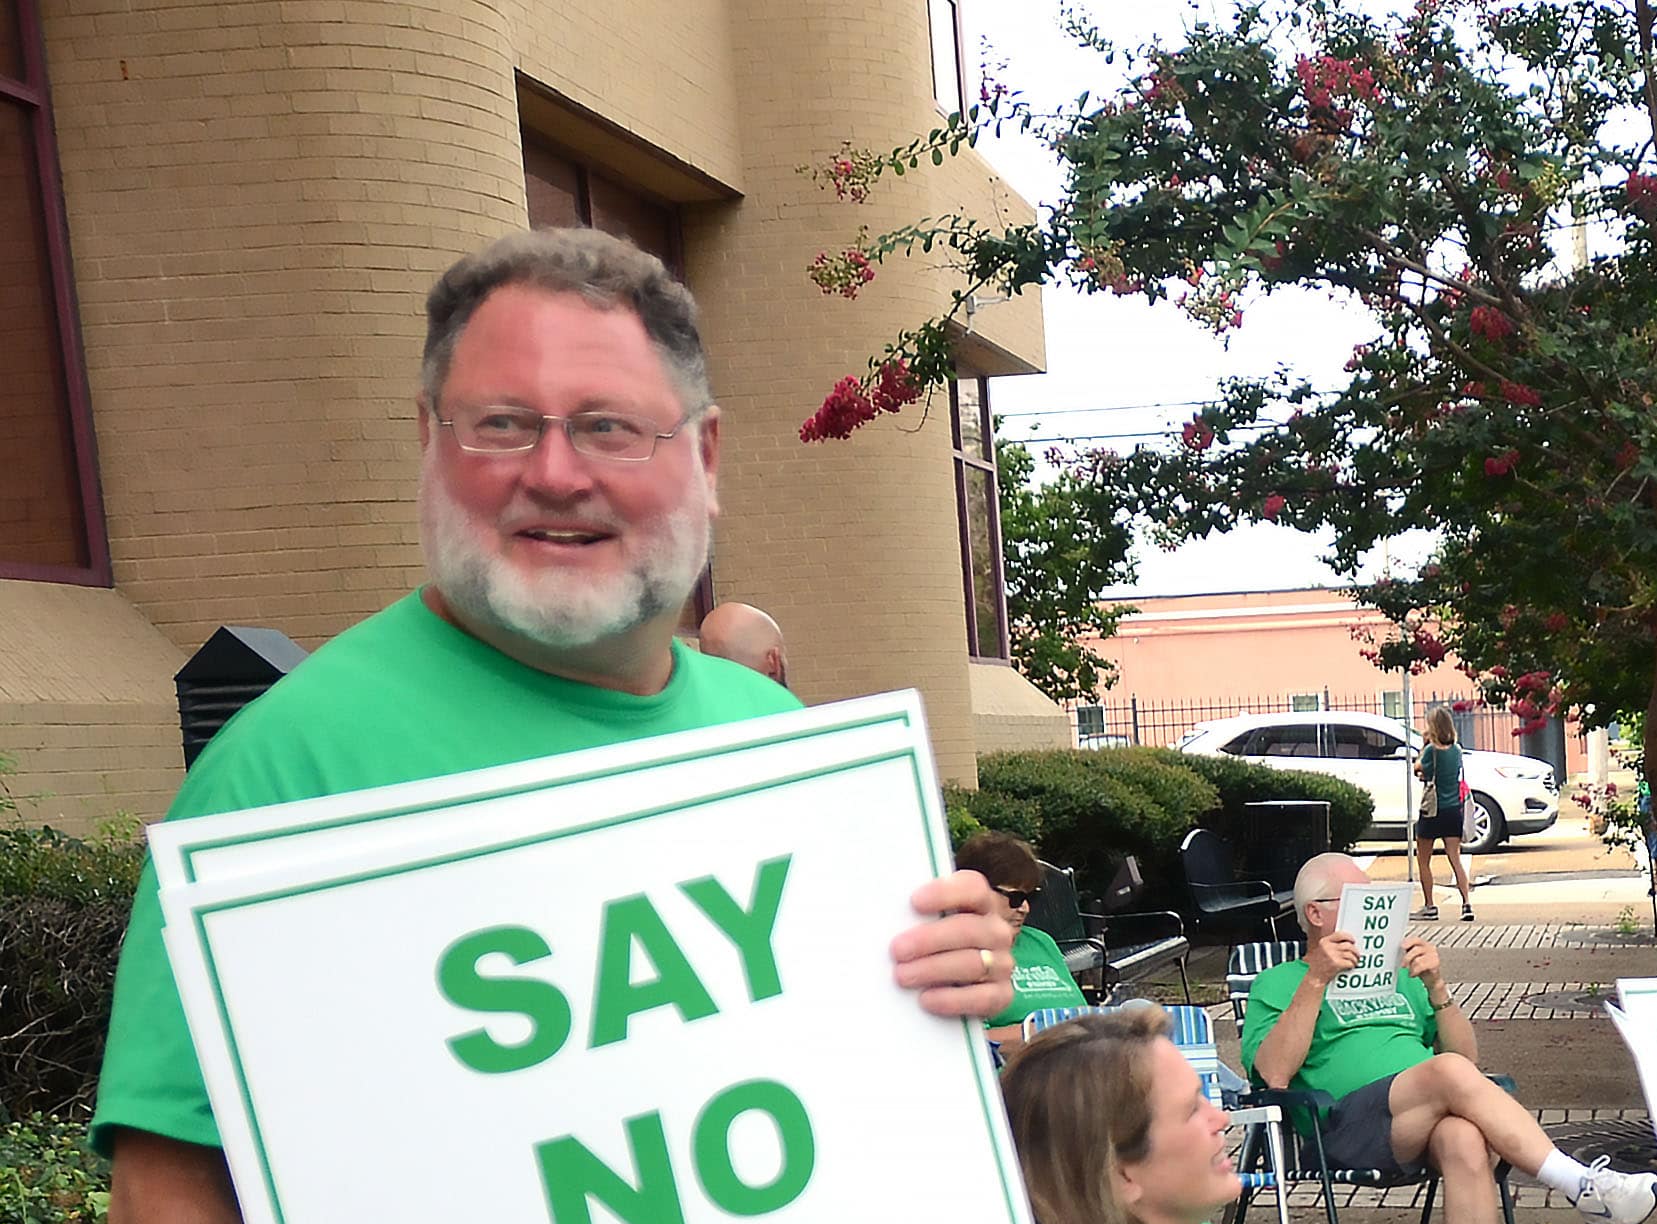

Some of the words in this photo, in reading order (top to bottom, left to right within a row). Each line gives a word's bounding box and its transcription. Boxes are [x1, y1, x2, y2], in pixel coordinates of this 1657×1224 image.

[1363, 895, 1397, 910] SAY
[1364, 915, 1389, 930] NO
[1363, 935, 1385, 949] TO
[437, 855, 793, 1076] SAY
[1357, 954, 1385, 969] BIG
[1336, 971, 1393, 988] SOLAR
